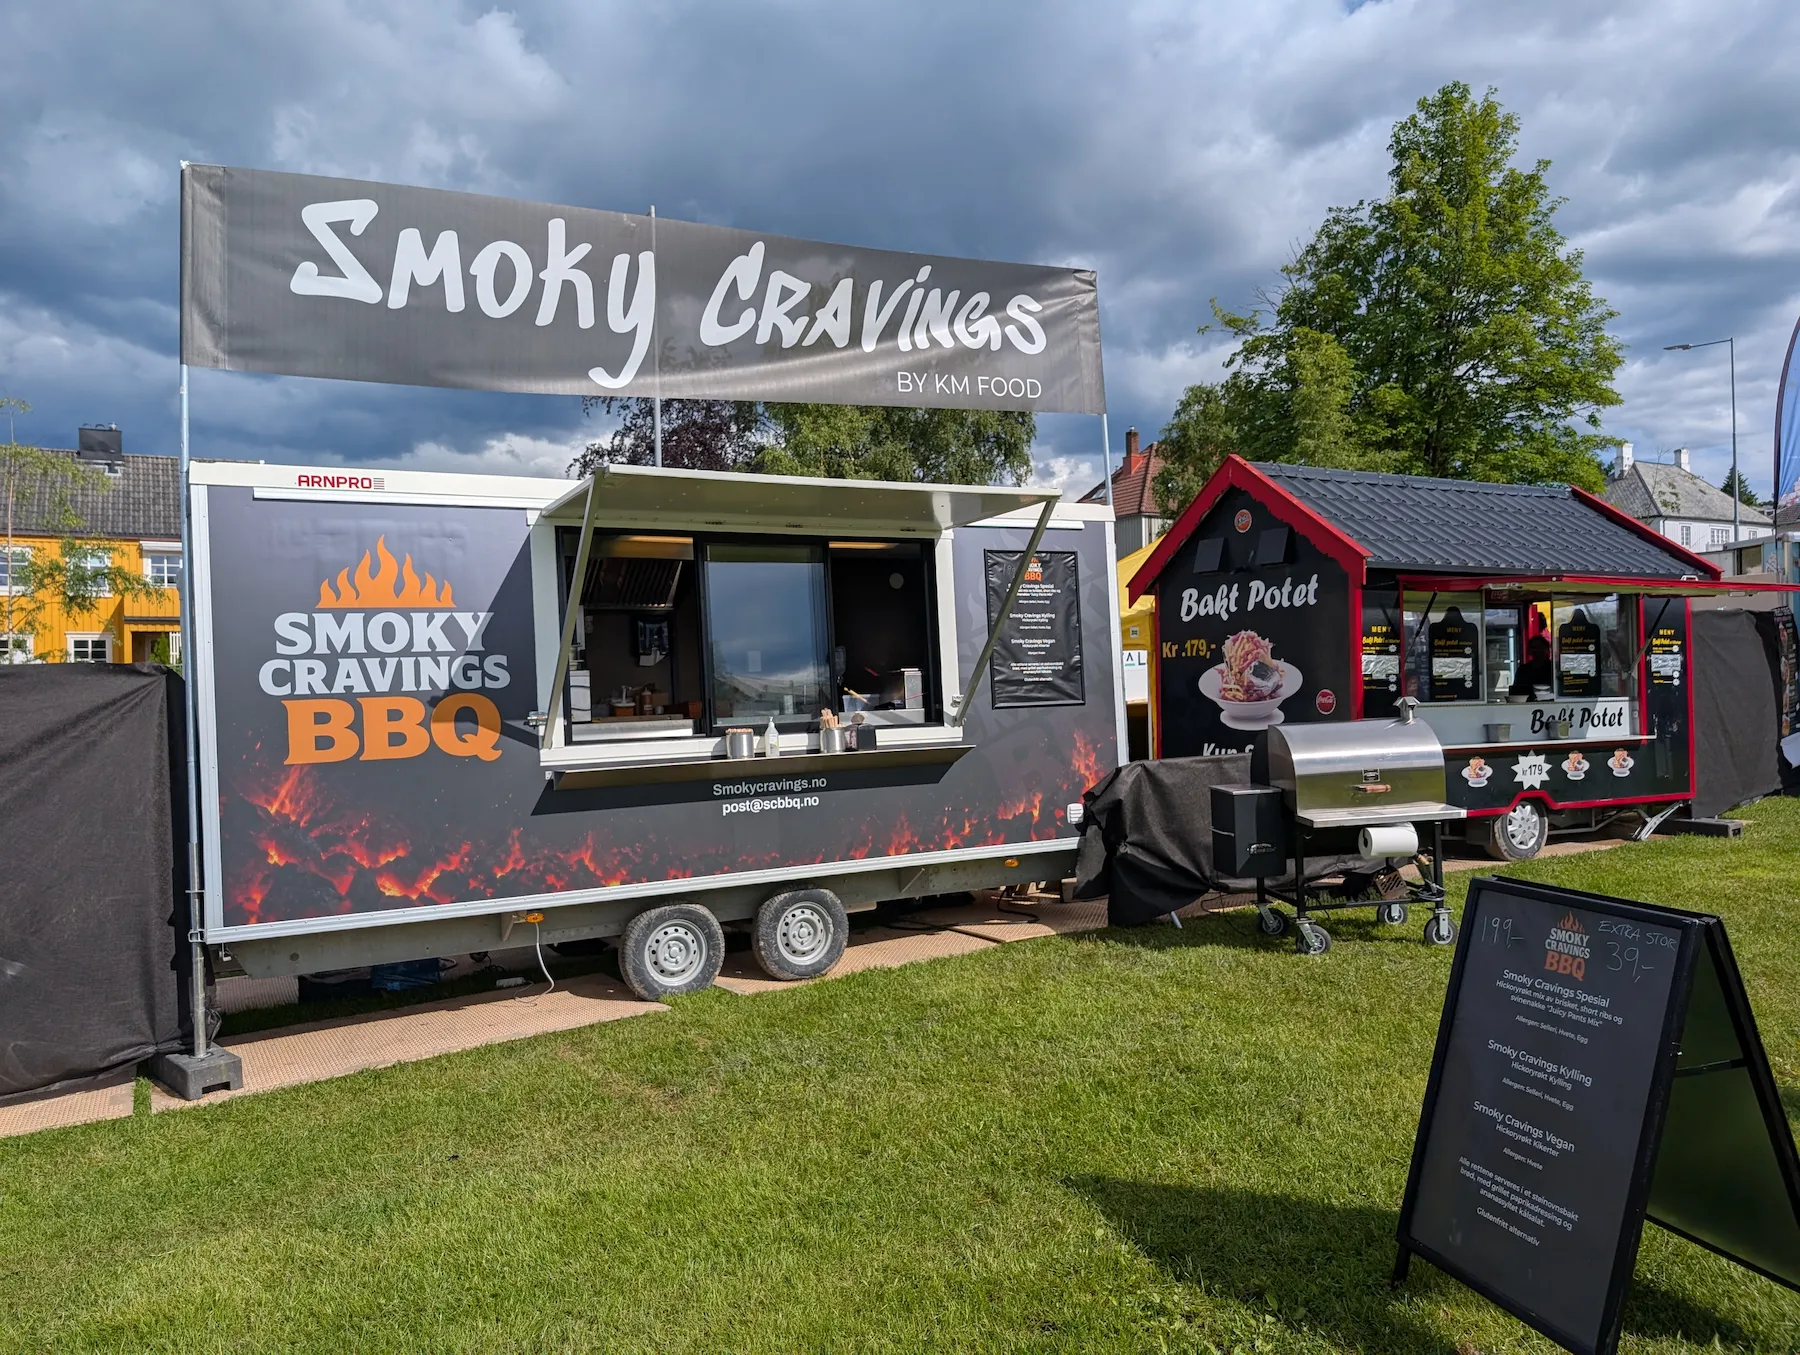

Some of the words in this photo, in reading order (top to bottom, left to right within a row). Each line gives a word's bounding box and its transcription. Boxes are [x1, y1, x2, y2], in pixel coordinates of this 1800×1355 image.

[898, 371, 929, 392] BY
[934, 373, 972, 395] KM
[978, 375, 1043, 398] FOOD
[297, 474, 373, 490] ARNPRO
[1180, 583, 1239, 622] Bakt
[1247, 573, 1319, 611] Potet
[274, 612, 495, 656] SMOKY
[1162, 642, 1178, 658] Kr
[258, 654, 511, 696] CRAVINGS
[281, 693, 503, 765] BBQ
[1580, 707, 1623, 728] Potet
[713, 778, 827, 796] Smokycravings.no
[722, 796, 820, 816] post@scbbq.no
[1550, 928, 1590, 947] SMOKY
[1598, 921, 1640, 940] EXTRA
[1545, 939, 1590, 959] CRAVINGS
[1544, 951, 1585, 981] BBQ
[1503, 969, 1534, 987] Smoky
[1535, 978, 1575, 998] Cravings
[1576, 990, 1610, 1008] Spesial
[1510, 994, 1546, 1011] svinenakke
[1567, 1011, 1586, 1023] Pants
[1533, 990, 1545, 1000] mix
[1545, 995, 1554, 1003] av
[1555, 997, 1579, 1011] brisket,
[1580, 1004, 1598, 1016] short
[1599, 1009, 1612, 1021] ribs
[1612, 1015, 1623, 1025] og
[1577, 1034, 1588, 1044] Egg
[1488, 1039, 1518, 1059] Smoky
[1519, 1050, 1559, 1072] Cravings
[1560, 1065, 1593, 1087] Kylling
[1549, 1075, 1572, 1091] Kylling
[1562, 1100, 1574, 1111] Egg
[1473, 1100, 1504, 1122] Smoky
[1505, 1114, 1544, 1138] Cravings
[1545, 1131, 1575, 1152] Vegan
[1532, 1140, 1560, 1157] Kikerter
[1459, 1156, 1470, 1167] Alle
[1470, 1162, 1494, 1179] rettene
[1494, 1173, 1520, 1192] serveres
[1524, 1189, 1532, 1198] et
[1532, 1193, 1580, 1222] steinovnsbakt
[1477, 1176, 1491, 1188] med
[1562, 1221, 1573, 1231] og
[1476, 1207, 1509, 1230] Glutenfritt
[1509, 1225, 1540, 1246] alternativ
